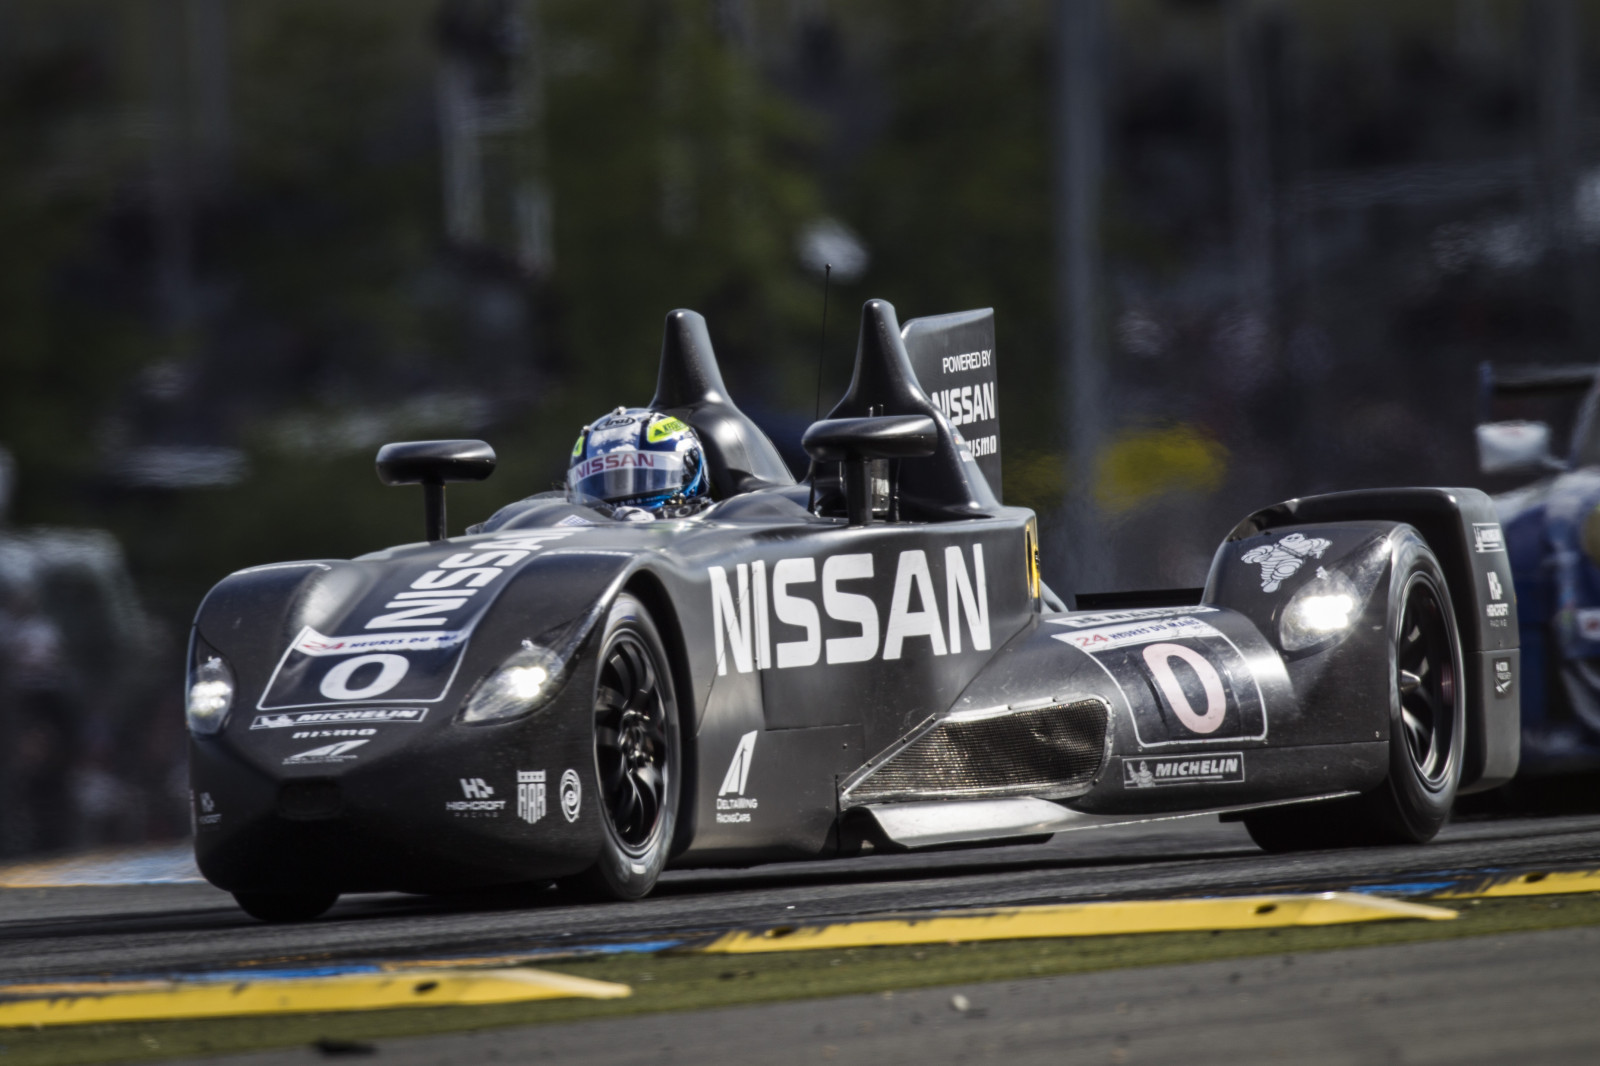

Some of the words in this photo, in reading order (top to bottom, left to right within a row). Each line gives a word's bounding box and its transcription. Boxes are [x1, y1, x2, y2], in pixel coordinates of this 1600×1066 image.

[942, 351, 981, 374] POWERED
[981, 349, 992, 367] BY
[575, 453, 655, 478] NISSAN
[364, 527, 596, 629] NISSAN
[708, 543, 991, 676] NISSAN
[303, 640, 346, 651] 24
[349, 638, 403, 648] HEURES
[408, 635, 431, 644] DU
[1076, 634, 1109, 647] 24
[1109, 627, 1150, 640] HEURES
[1149, 624, 1167, 634] DU
[1168, 618, 1201, 630] MANS
[320, 653, 410, 700] 0
[1142, 643, 1227, 733] 0
[297, 709, 419, 722] MICHELIN
[1155, 758, 1238, 777] MICHELIN
[446, 800, 506, 811] HIGHCROFT
